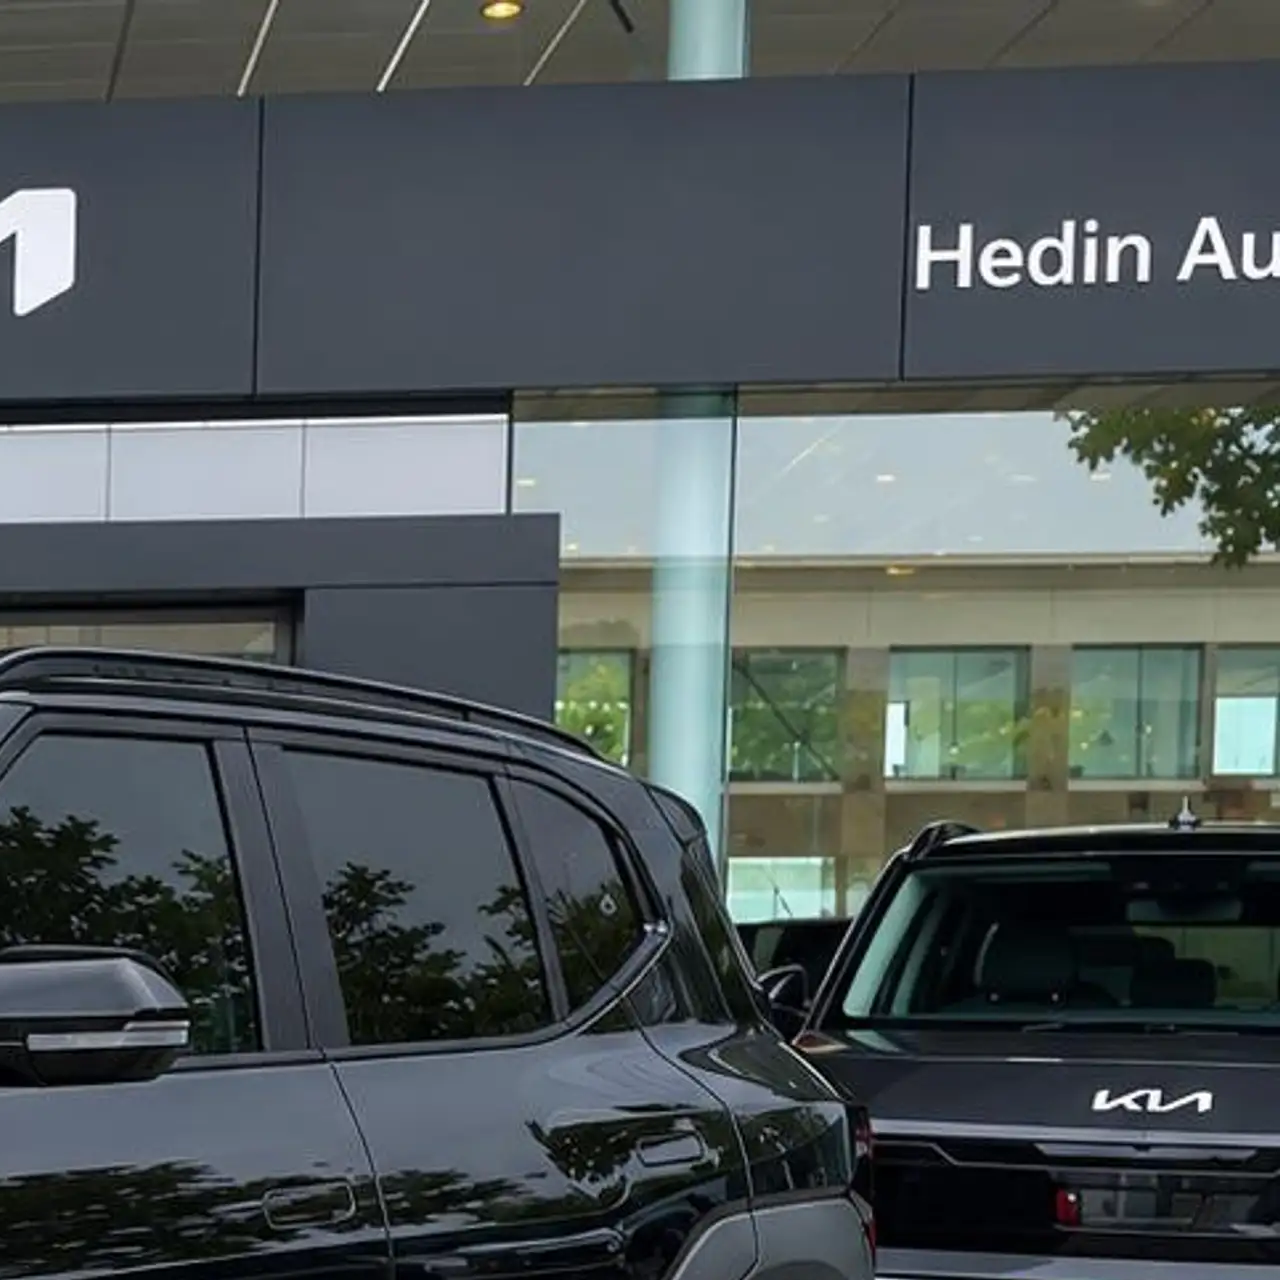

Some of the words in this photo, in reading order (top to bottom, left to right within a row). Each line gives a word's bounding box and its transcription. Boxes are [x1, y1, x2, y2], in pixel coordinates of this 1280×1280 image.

[915, 218, 1151, 290] Hedin
[1176, 216, 1280, 281] Au
[1091, 1088, 1213, 1114] KIA
